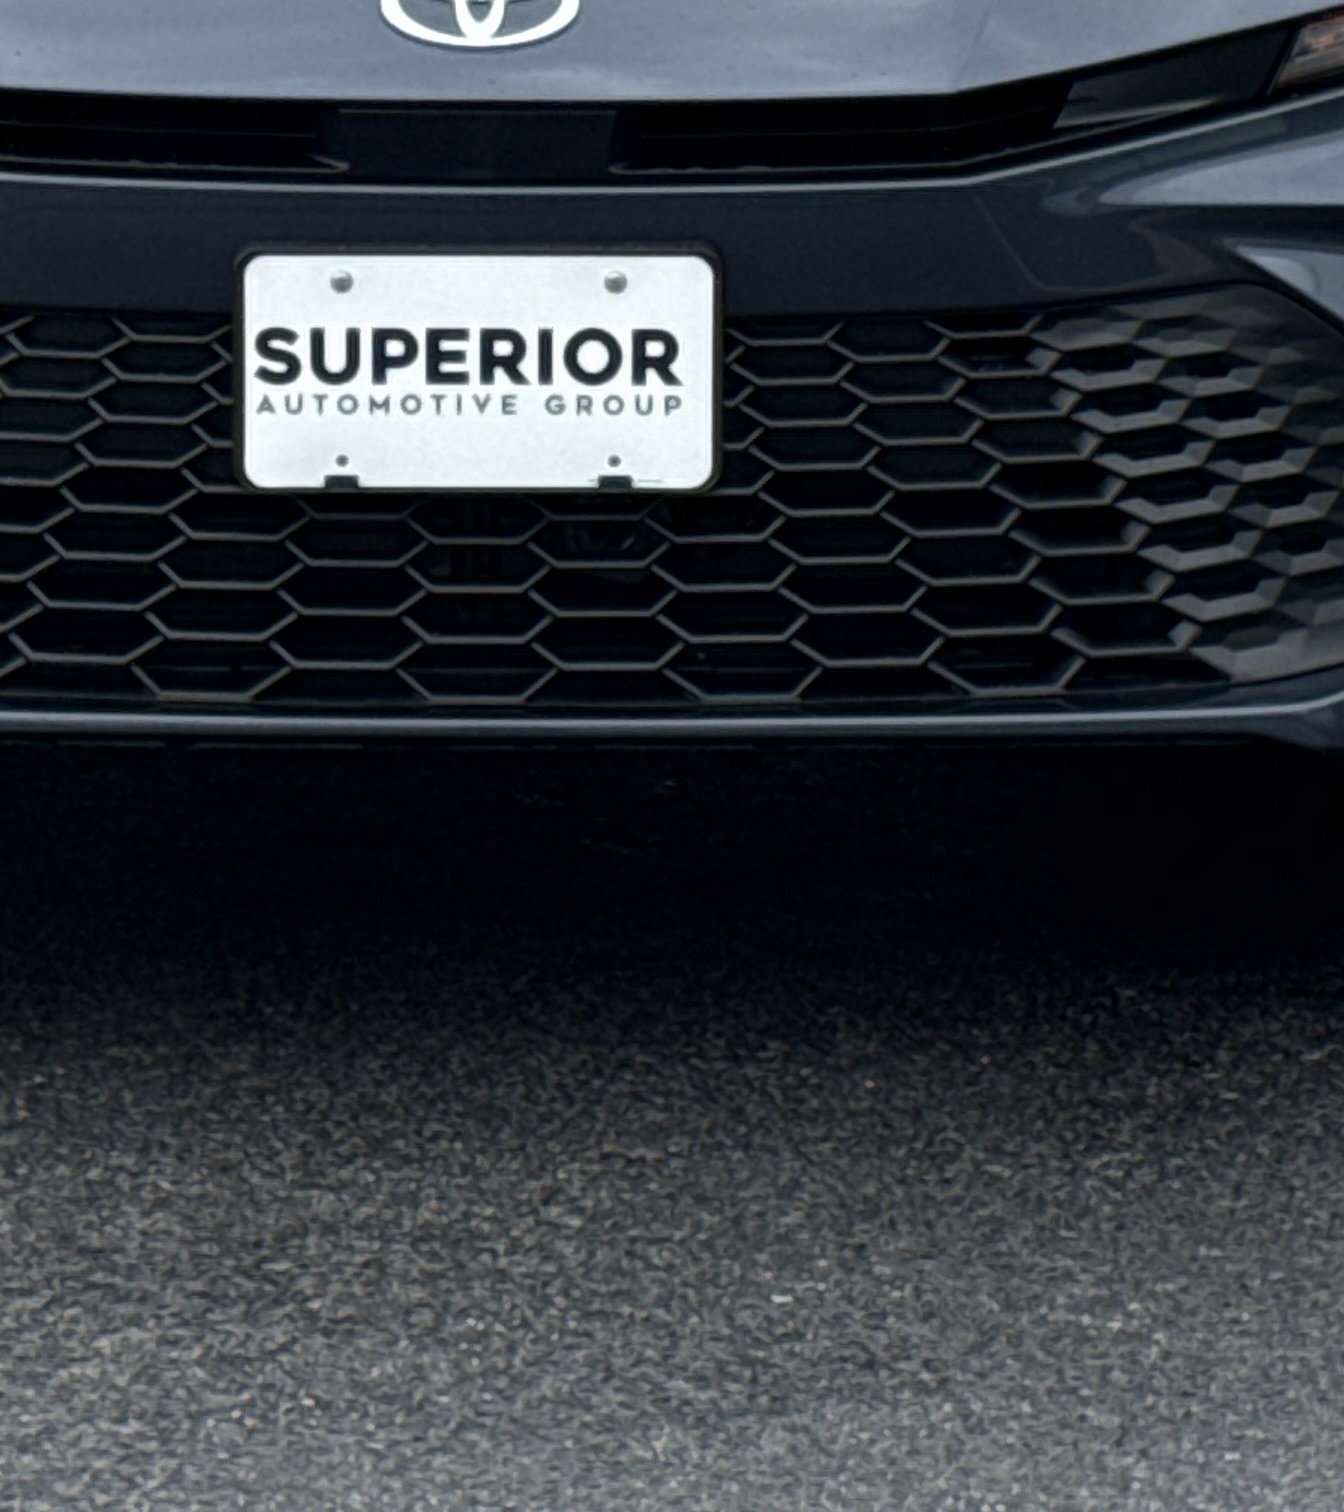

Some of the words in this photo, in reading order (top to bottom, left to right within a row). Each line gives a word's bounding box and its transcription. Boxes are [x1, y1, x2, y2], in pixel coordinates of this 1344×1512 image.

[255, 327, 684, 386] SUPERIOR
[256, 393, 520, 416] AUTOMOTIVE
[544, 393, 683, 416] GROUP
